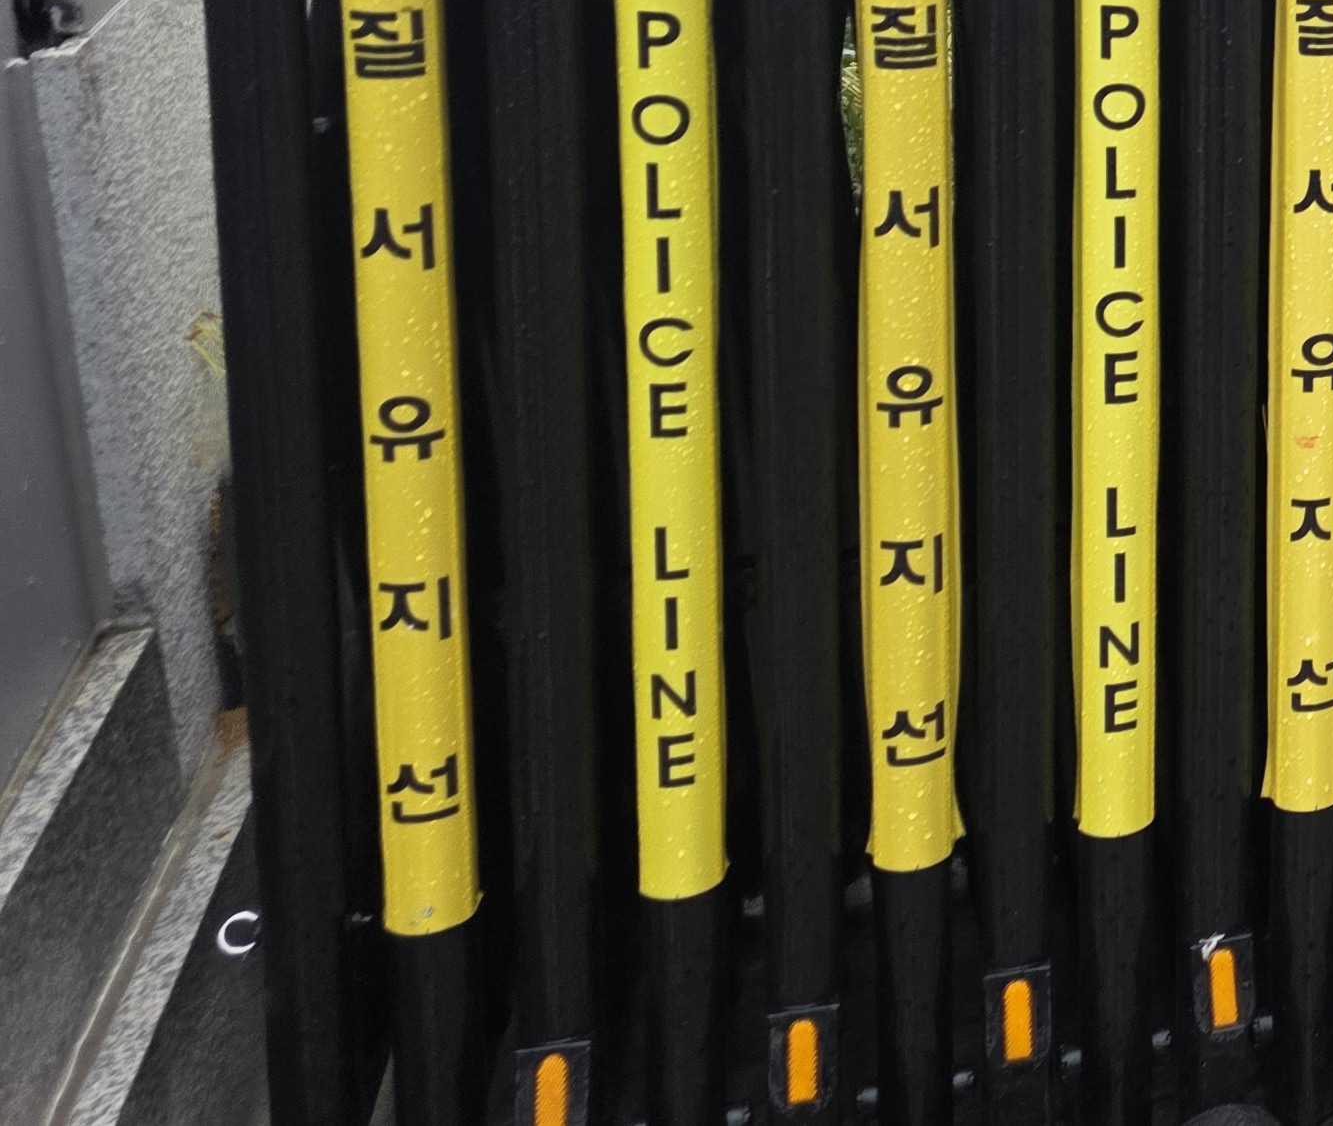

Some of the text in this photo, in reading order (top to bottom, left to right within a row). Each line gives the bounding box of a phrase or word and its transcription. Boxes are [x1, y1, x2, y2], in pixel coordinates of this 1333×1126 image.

[350, 8, 460, 825] 질서유지선
[632, 10, 697, 788] POLICE LINE
[870, 5, 946, 766] 질서유지선
[1094, 4, 1145, 733] POLICE LINE
